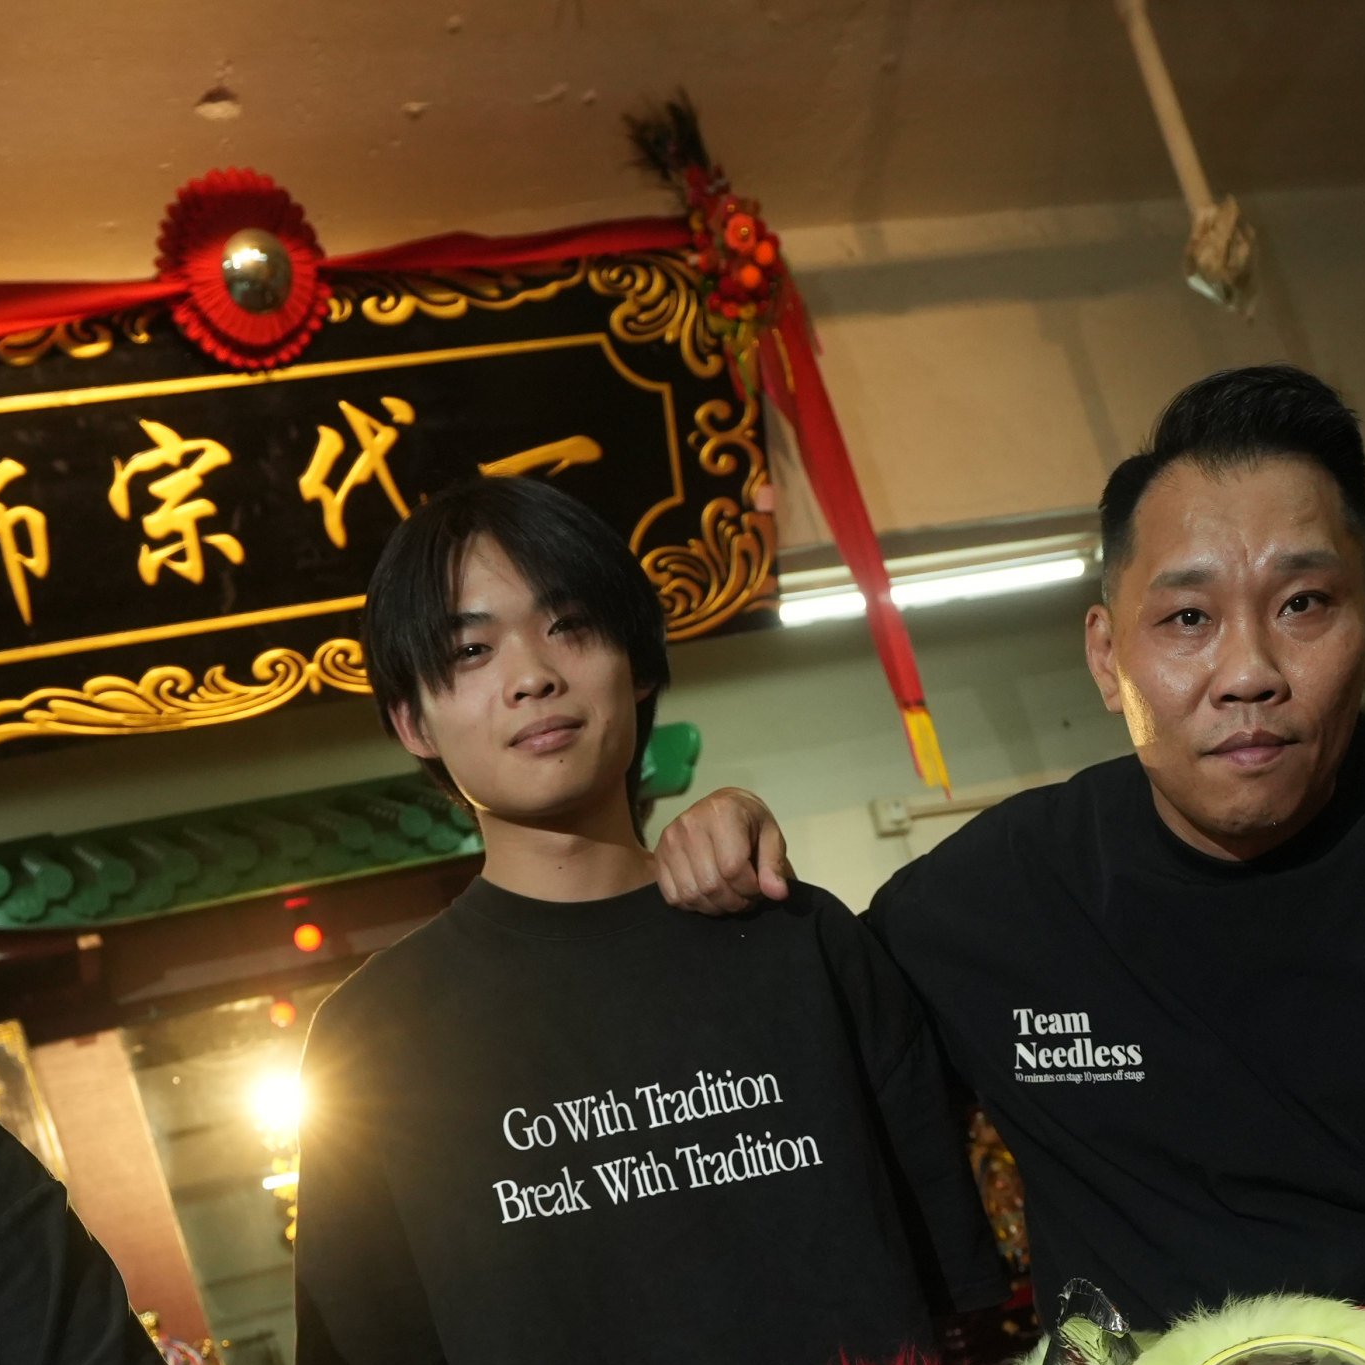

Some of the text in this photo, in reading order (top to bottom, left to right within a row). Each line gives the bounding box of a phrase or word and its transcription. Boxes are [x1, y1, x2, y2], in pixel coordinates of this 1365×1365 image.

[1013, 1008, 1092, 1036] Team
[1014, 1038, 1143, 1070] Needless
[1024, 1073, 1056, 1083] minutes
[1055, 1074, 1067, 1082] on
[1066, 1072, 1084, 1085] stage
[1083, 1071, 1092, 1082] 10
[1092, 1071, 1113, 1084] years
[1112, 1069, 1124, 1081] off
[1123, 1070, 1146, 1083] stage
[502, 1069, 784, 1151] Go With Tradition
[492, 1131, 823, 1224] Break With Tradition
